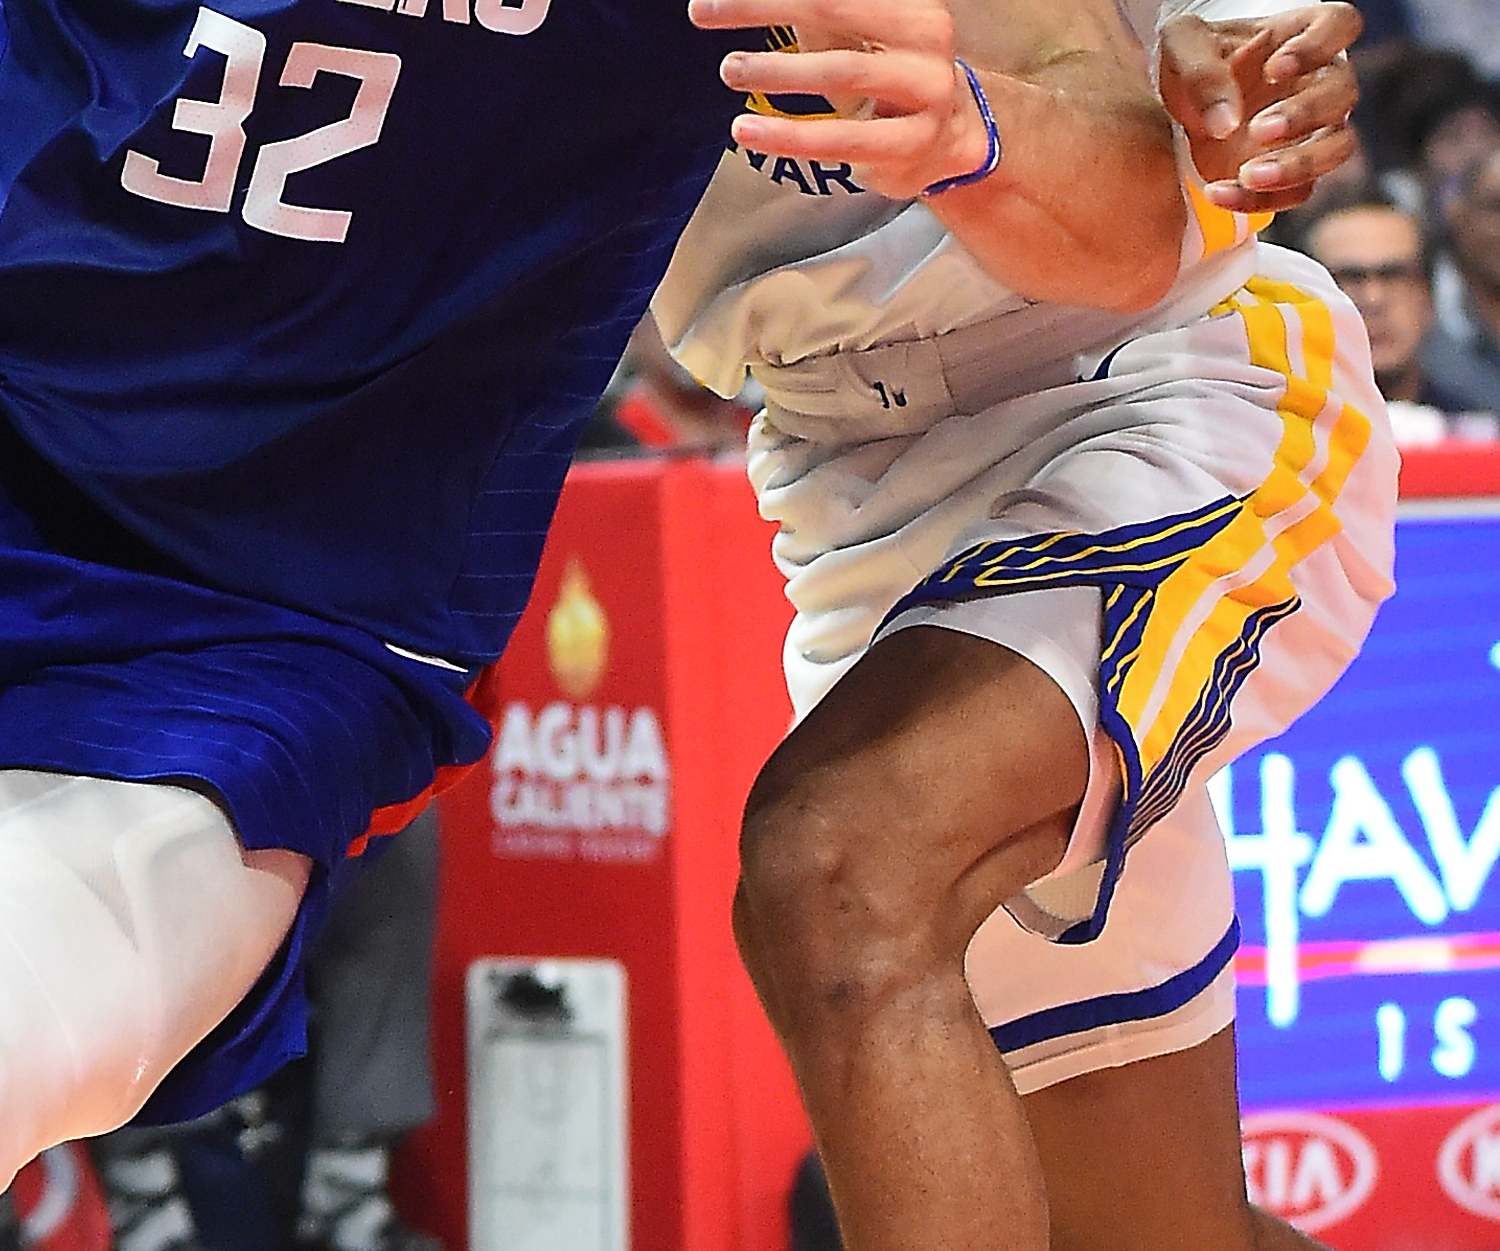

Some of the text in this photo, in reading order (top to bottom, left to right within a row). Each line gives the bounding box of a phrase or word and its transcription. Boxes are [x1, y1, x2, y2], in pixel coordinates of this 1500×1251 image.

[120, 6, 402, 244] 32
[494, 701, 669, 782] AGUA
[1375, 996, 1476, 1082] IS
